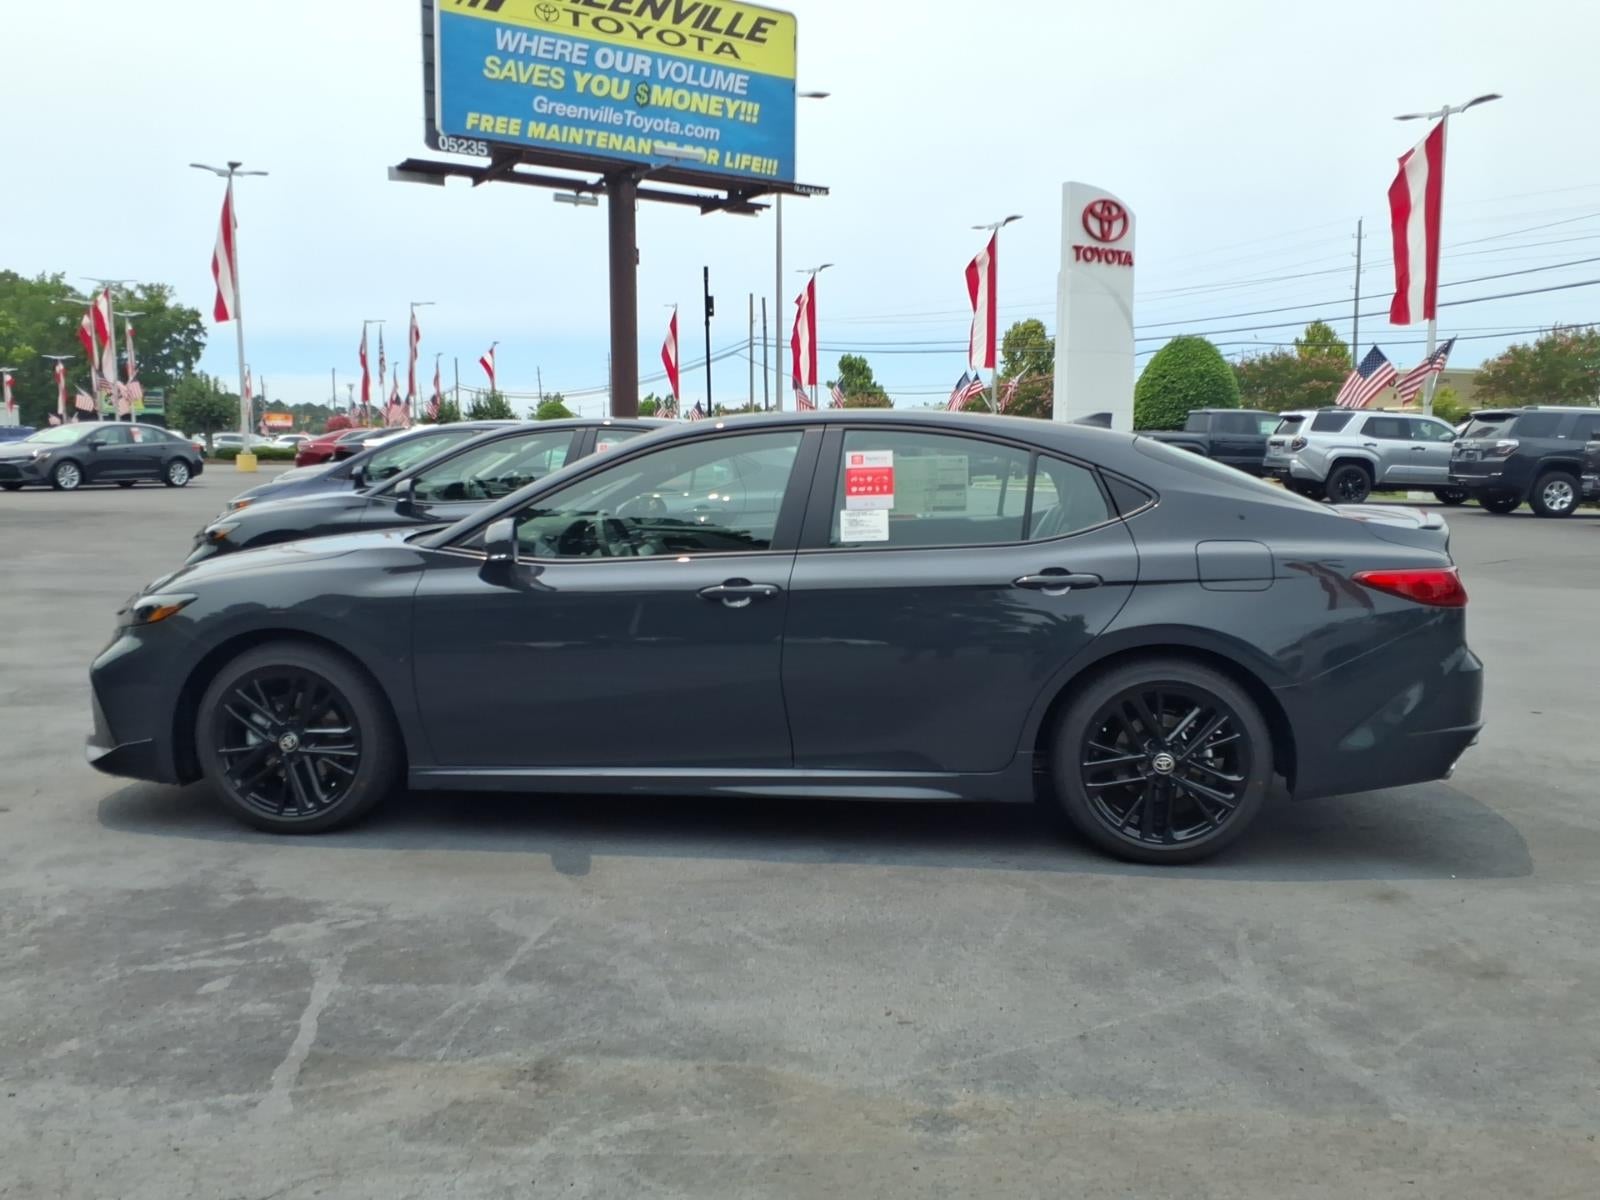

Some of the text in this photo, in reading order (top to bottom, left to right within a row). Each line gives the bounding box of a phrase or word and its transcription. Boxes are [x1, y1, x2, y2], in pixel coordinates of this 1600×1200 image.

[562, 8, 741, 60] TOYOTA
[483, 55, 565, 90] SAVES
[573, 70, 630, 101] YOU
[495, 27, 749, 96] WHERE OUR VOLUME
[532, 95, 721, 141] GreenvilleToyota.com
[438, 135, 488, 157] 05235
[465, 112, 521, 136] FREE
[724, 151, 779, 176] LIFE!!!
[1072, 244, 1134, 267] TOYOTA
